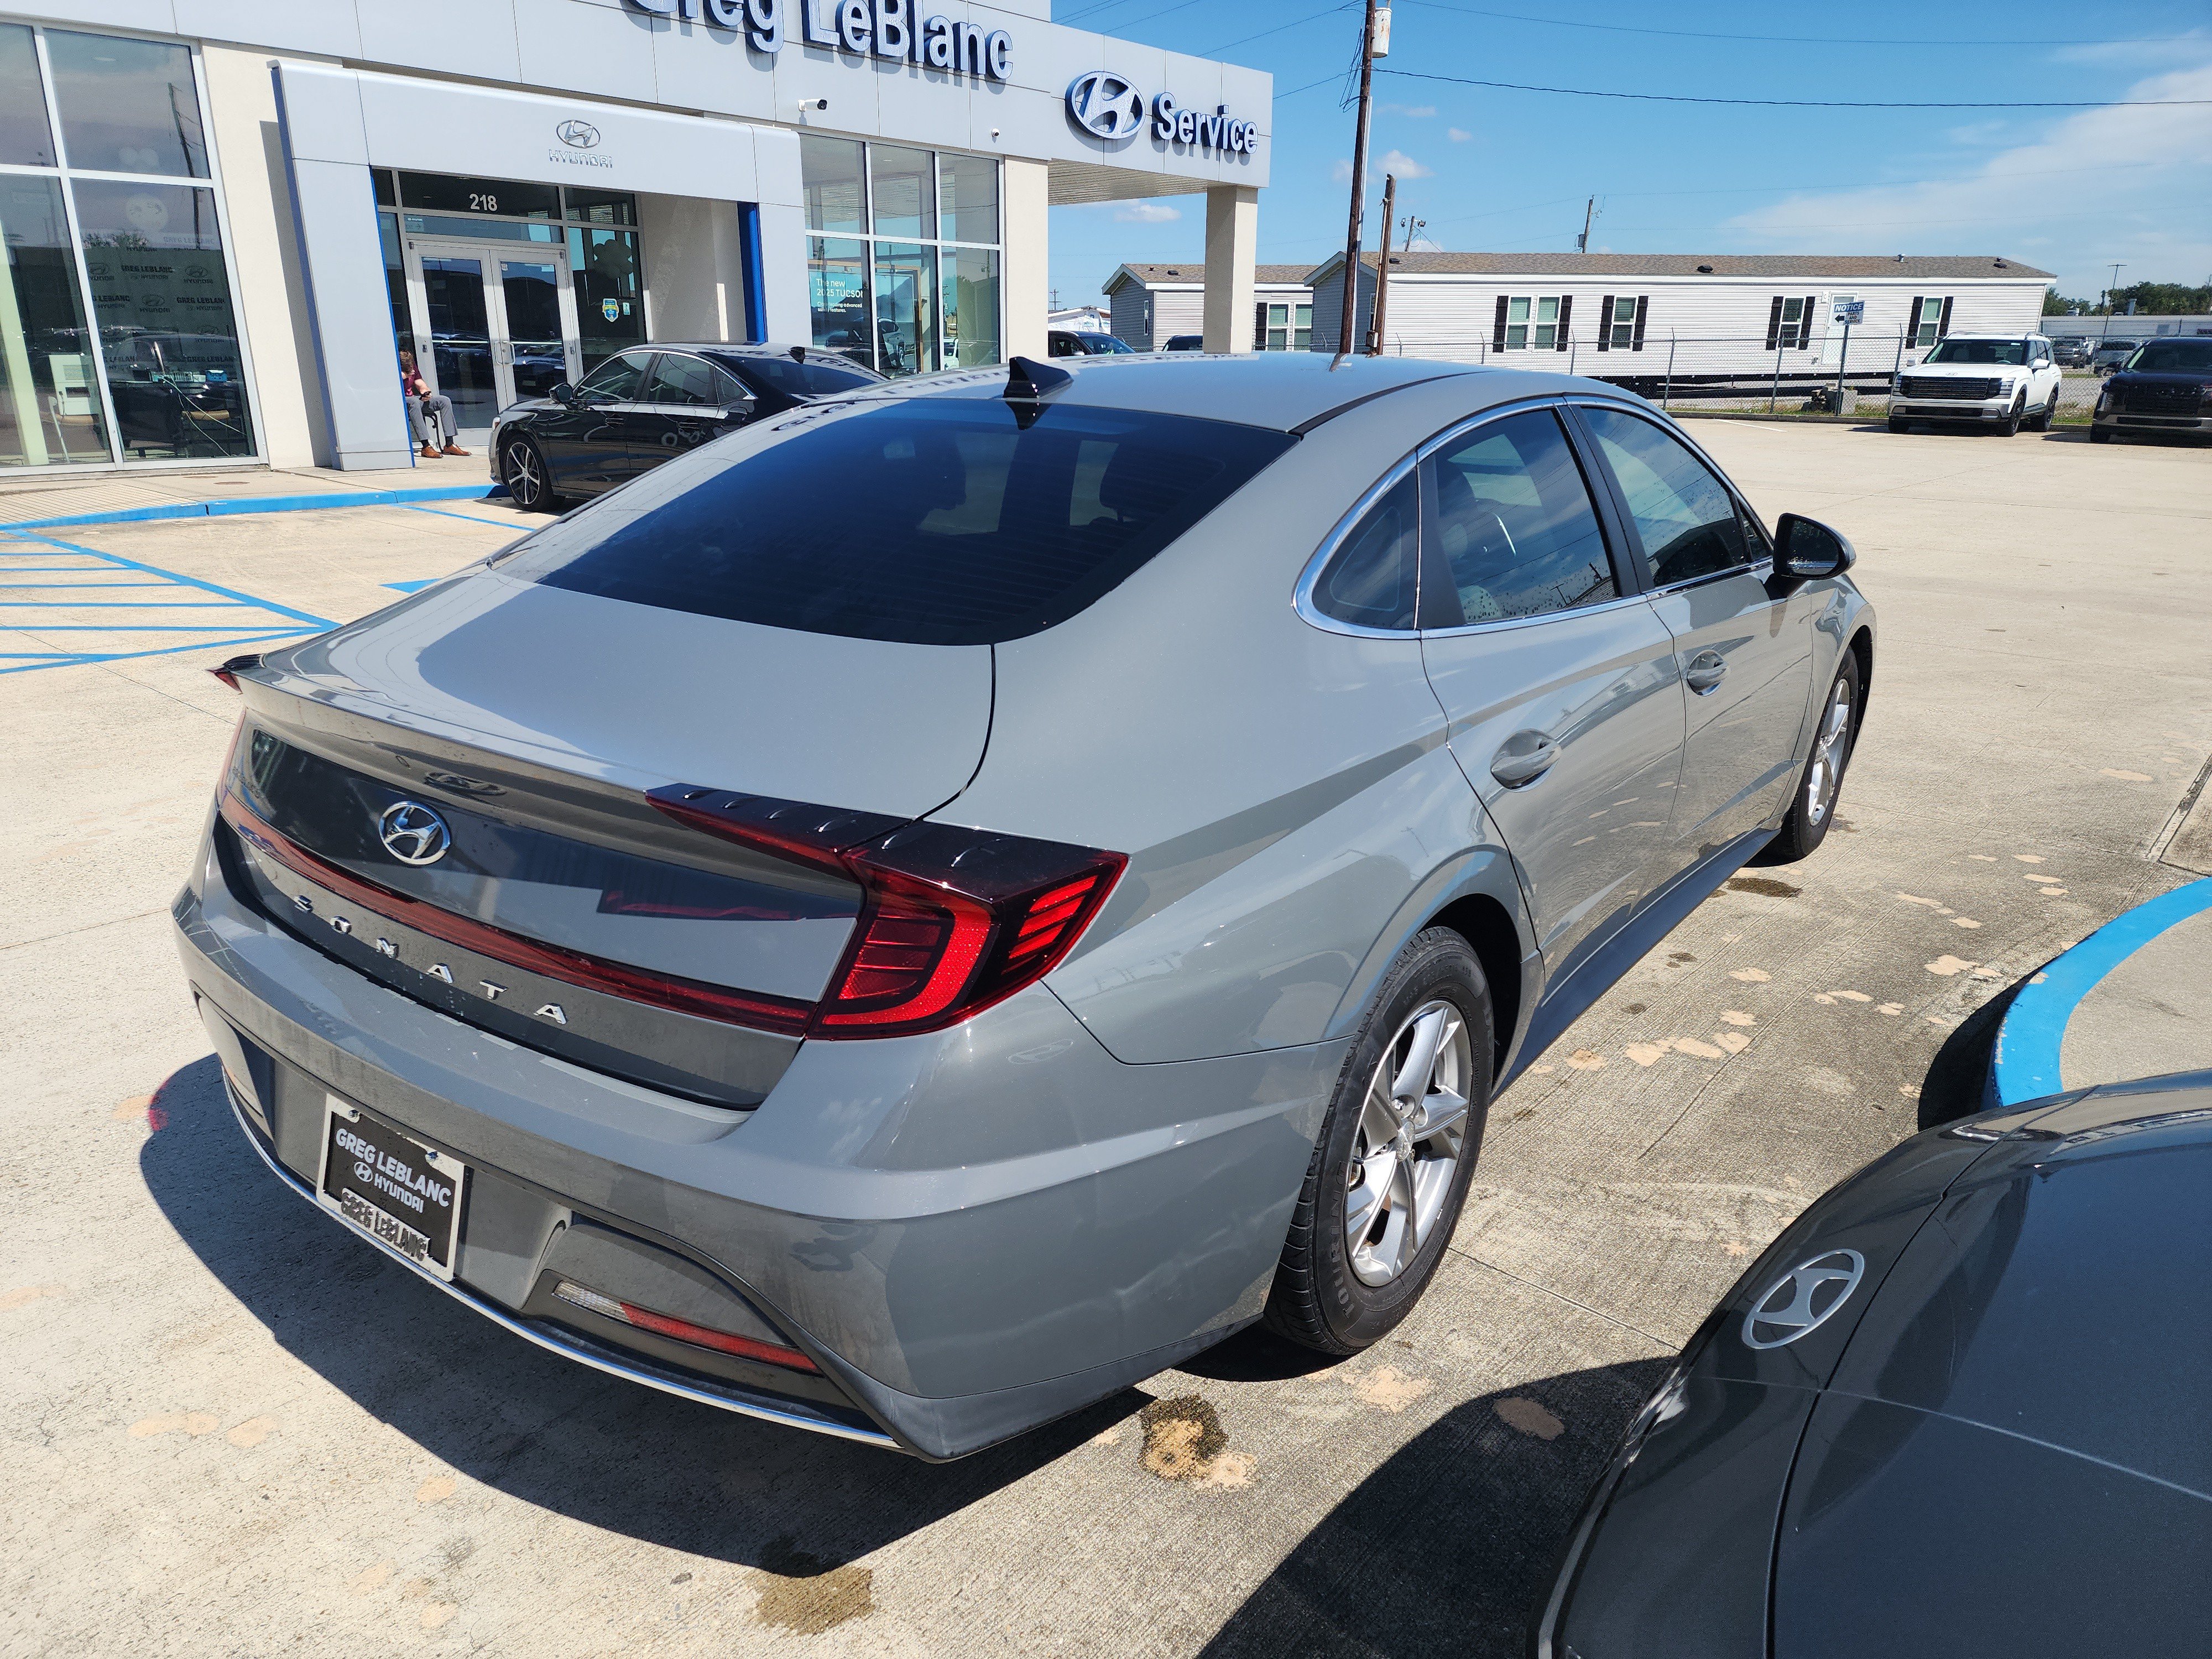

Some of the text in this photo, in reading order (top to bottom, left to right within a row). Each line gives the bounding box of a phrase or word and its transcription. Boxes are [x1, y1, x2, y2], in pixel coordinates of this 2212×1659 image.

[801, 0, 1013, 79] LeBlanc
[1151, 92, 1259, 154] Service
[549, 149, 612, 168] HYUNDAI
[469, 194, 498, 211] 218
[816, 278, 829, 286] The
[817, 288, 834, 296] 2025
[1835, 303, 1863, 312] NOTICE
[294, 894, 567, 1025] SONATA
[336, 1128, 452, 1207] GREG LEBLANC
[374, 1173, 424, 1213] HYUNDAI
